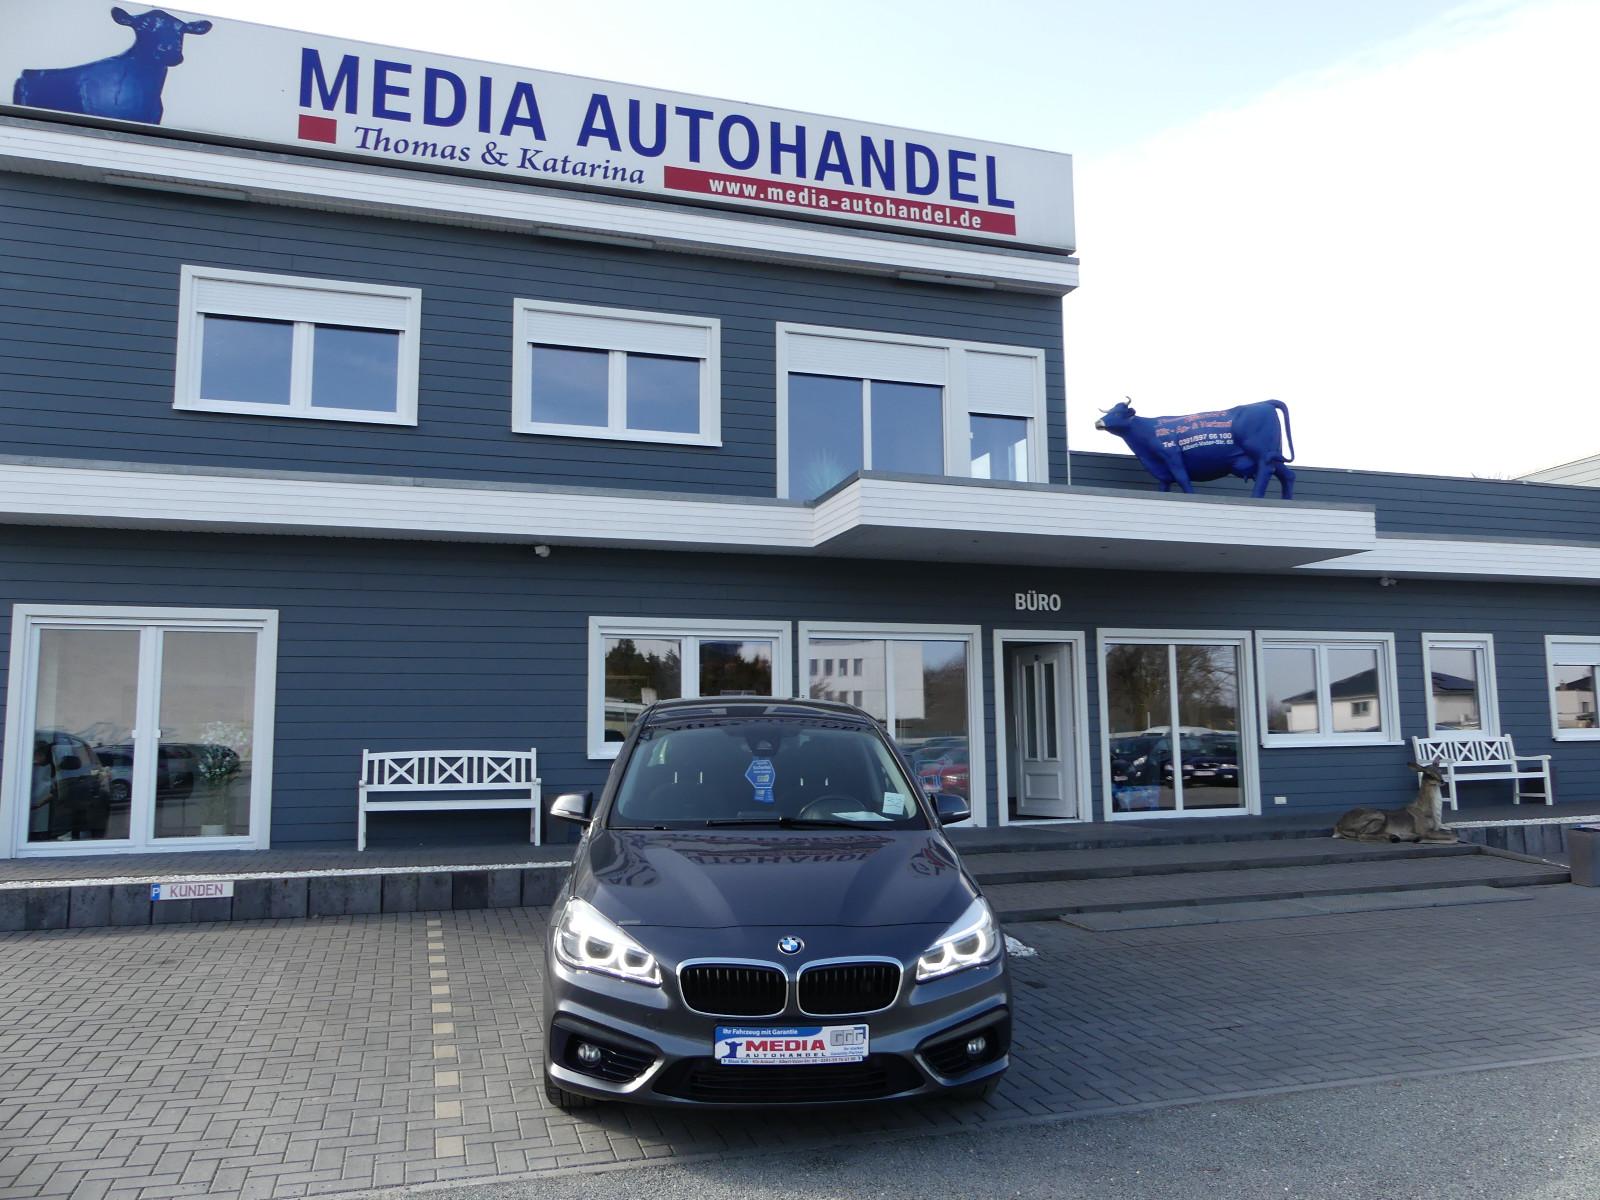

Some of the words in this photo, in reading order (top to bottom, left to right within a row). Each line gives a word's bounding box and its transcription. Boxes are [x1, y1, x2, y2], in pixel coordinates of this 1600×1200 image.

[299, 47, 546, 142] MEDIA
[576, 93, 1016, 209] AUTOHANDEL
[354, 126, 471, 162] Thomas
[481, 141, 509, 168] &
[517, 147, 645, 184] Katarina
[708, 177, 983, 229] www.media-autohandel.de
[1015, 590, 1061, 611] BÜRO
[152, 887, 160, 897] P
[170, 884, 224, 897] KUNDEN
[732, 1028, 760, 1036] Fahrzeug
[745, 1040, 826, 1051] MEDIA
